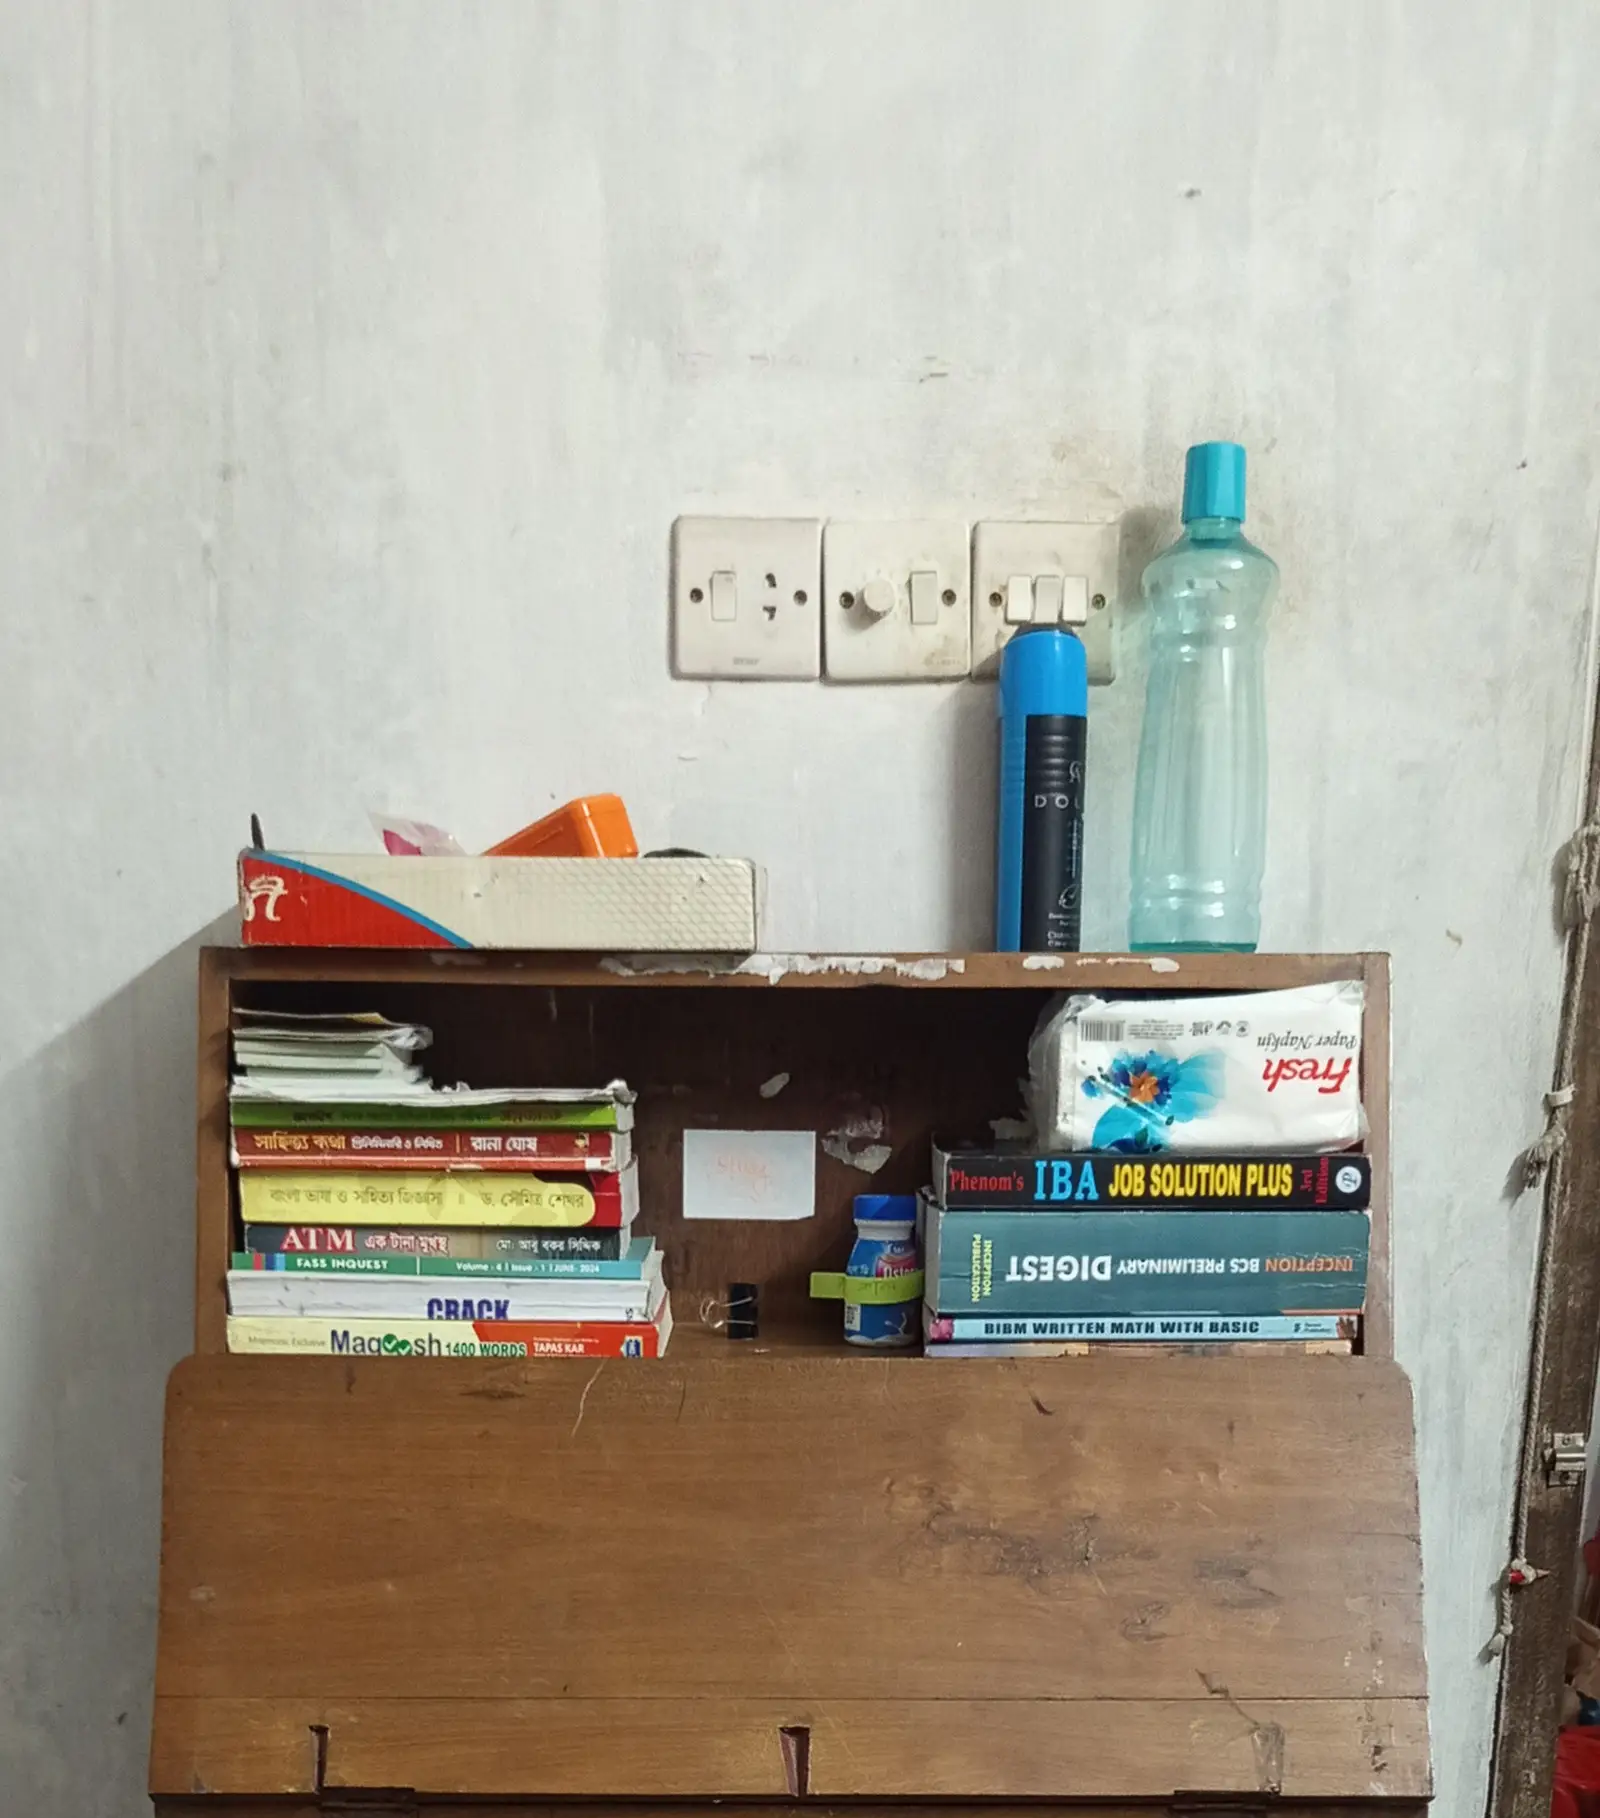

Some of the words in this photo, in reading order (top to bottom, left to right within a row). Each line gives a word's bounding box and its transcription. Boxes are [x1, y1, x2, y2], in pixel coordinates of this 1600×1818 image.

[1257, 1032, 1313, 1053] Napkin
[1316, 1031, 1357, 1051] Paper
[1263, 1057, 1352, 1094] Fresh
[312, 1134, 345, 1150] কথা
[470, 1136, 502, 1151] রানা
[506, 1136, 537, 1151] ঘোষ
[950, 1168, 1025, 1191] Phenom's
[1034, 1160, 1099, 1200] IBA
[1109, 1165, 1147, 1197] JOB
[1150, 1164, 1241, 1197] SOLUTION
[1246, 1164, 1293, 1196] PLUS
[270, 1188, 300, 1203] বাংলা
[304, 1188, 331, 1204] ভাষা
[338, 1190, 348, 1203] ও
[354, 1186, 394, 1205] সাহিত্য
[548, 1192, 585, 1208] শেখর
[281, 1227, 356, 1251] ATM
[364, 1234, 387, 1249] এক
[389, 1232, 415, 1250] টানা
[296, 1257, 328, 1269] FASS
[332, 1258, 389, 1270] INQUEST
[456, 1262, 489, 1272] Volume
[511, 1263, 533, 1272] Issue
[580, 1263, 601, 1273] 2024
[971, 1234, 982, 1303] PUBLICATION
[983, 1239, 993, 1296] INCEPTION
[1005, 1255, 1112, 1281] DIGEST
[1117, 1258, 1226, 1275] PRELIMINARY
[1230, 1257, 1260, 1274] BCS
[1265, 1257, 1353, 1273] INCEPTION
[427, 1298, 510, 1320] CRACK
[984, 1322, 1028, 1335] BIBM
[1033, 1322, 1105, 1334] WRITTEN
[1110, 1321, 1155, 1334] MATH
[1161, 1321, 1205, 1334] WITH
[1209, 1320, 1260, 1334] BASIC
[445, 1342, 476, 1357] 1400
[479, 1342, 528, 1357] WORDS
[533, 1342, 563, 1353] TAPAS
[565, 1342, 585, 1354] KAR
